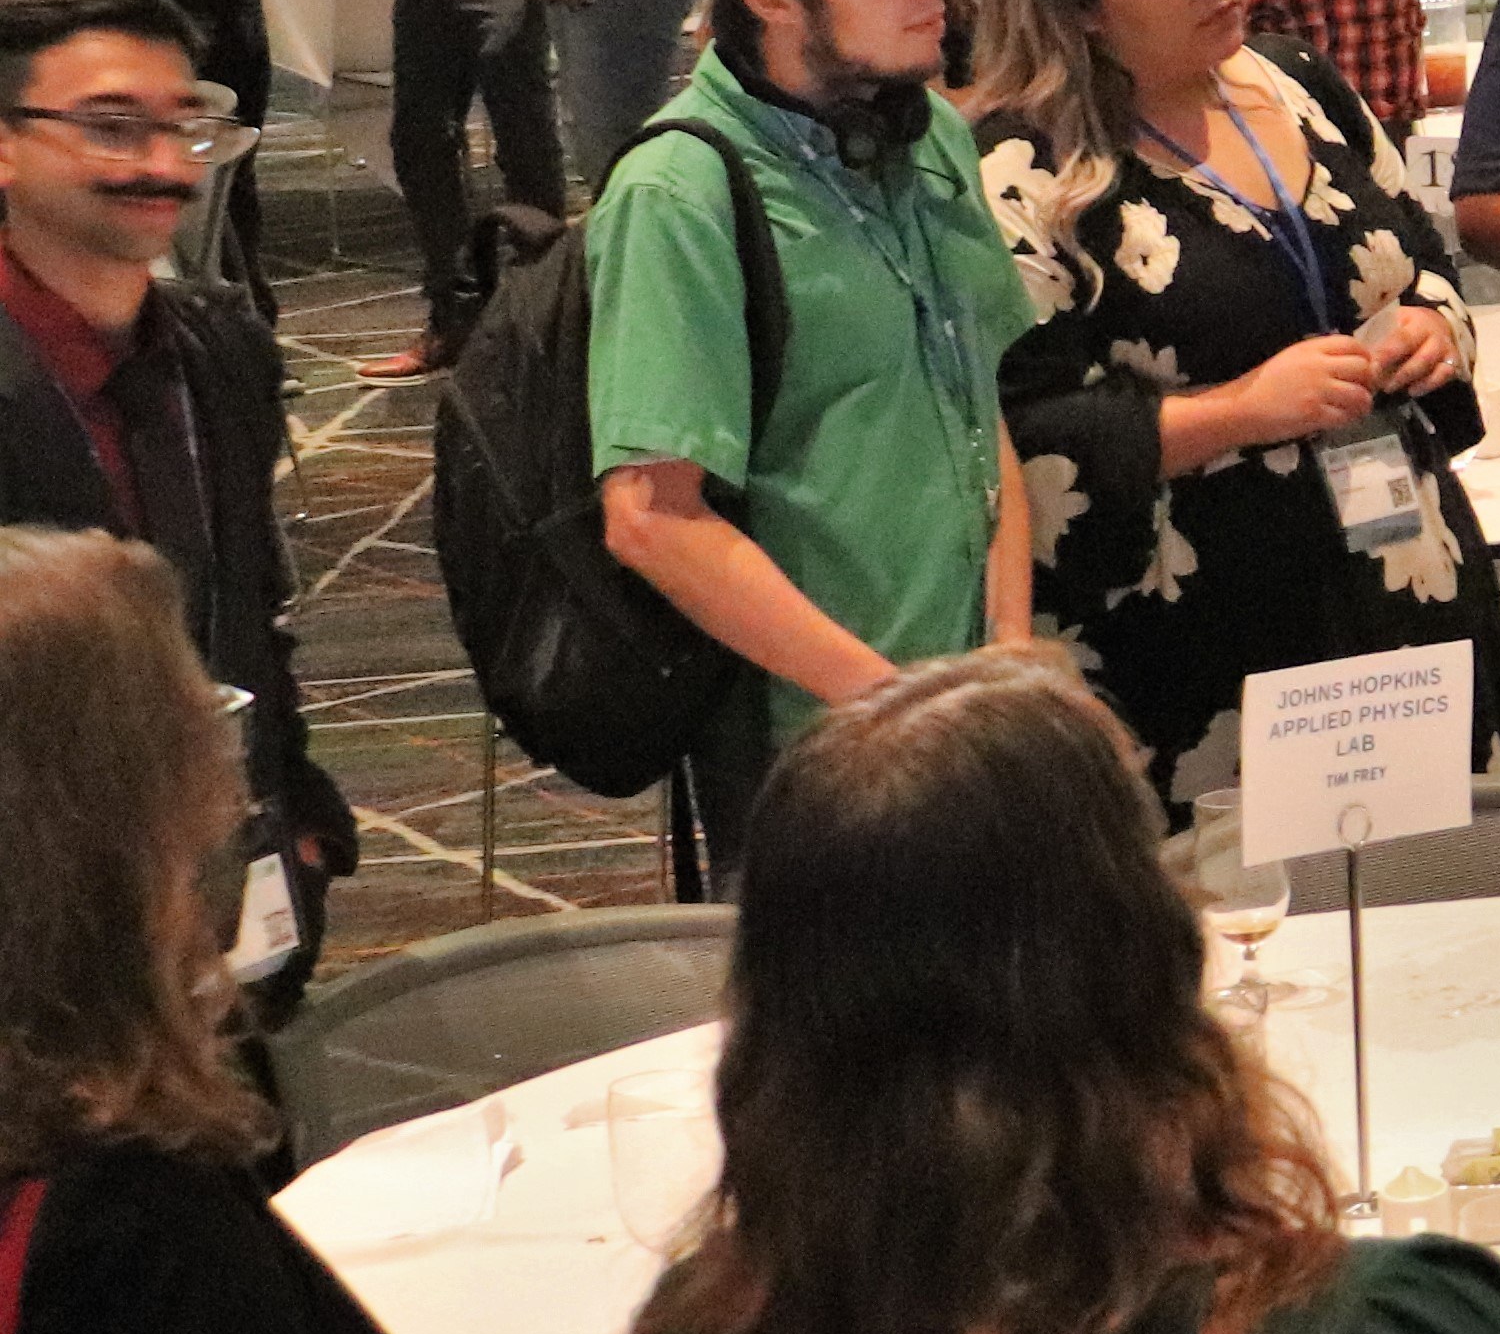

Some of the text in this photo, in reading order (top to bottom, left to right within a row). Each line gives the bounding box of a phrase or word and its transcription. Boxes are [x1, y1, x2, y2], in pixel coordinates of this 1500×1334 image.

[1277, 667, 1441, 709] JOHNS HOPKINS
[1269, 696, 1448, 740] APPLIED PHYSICS
[1336, 734, 1375, 757] LAB
[1327, 767, 1387, 788] TIM FREY
